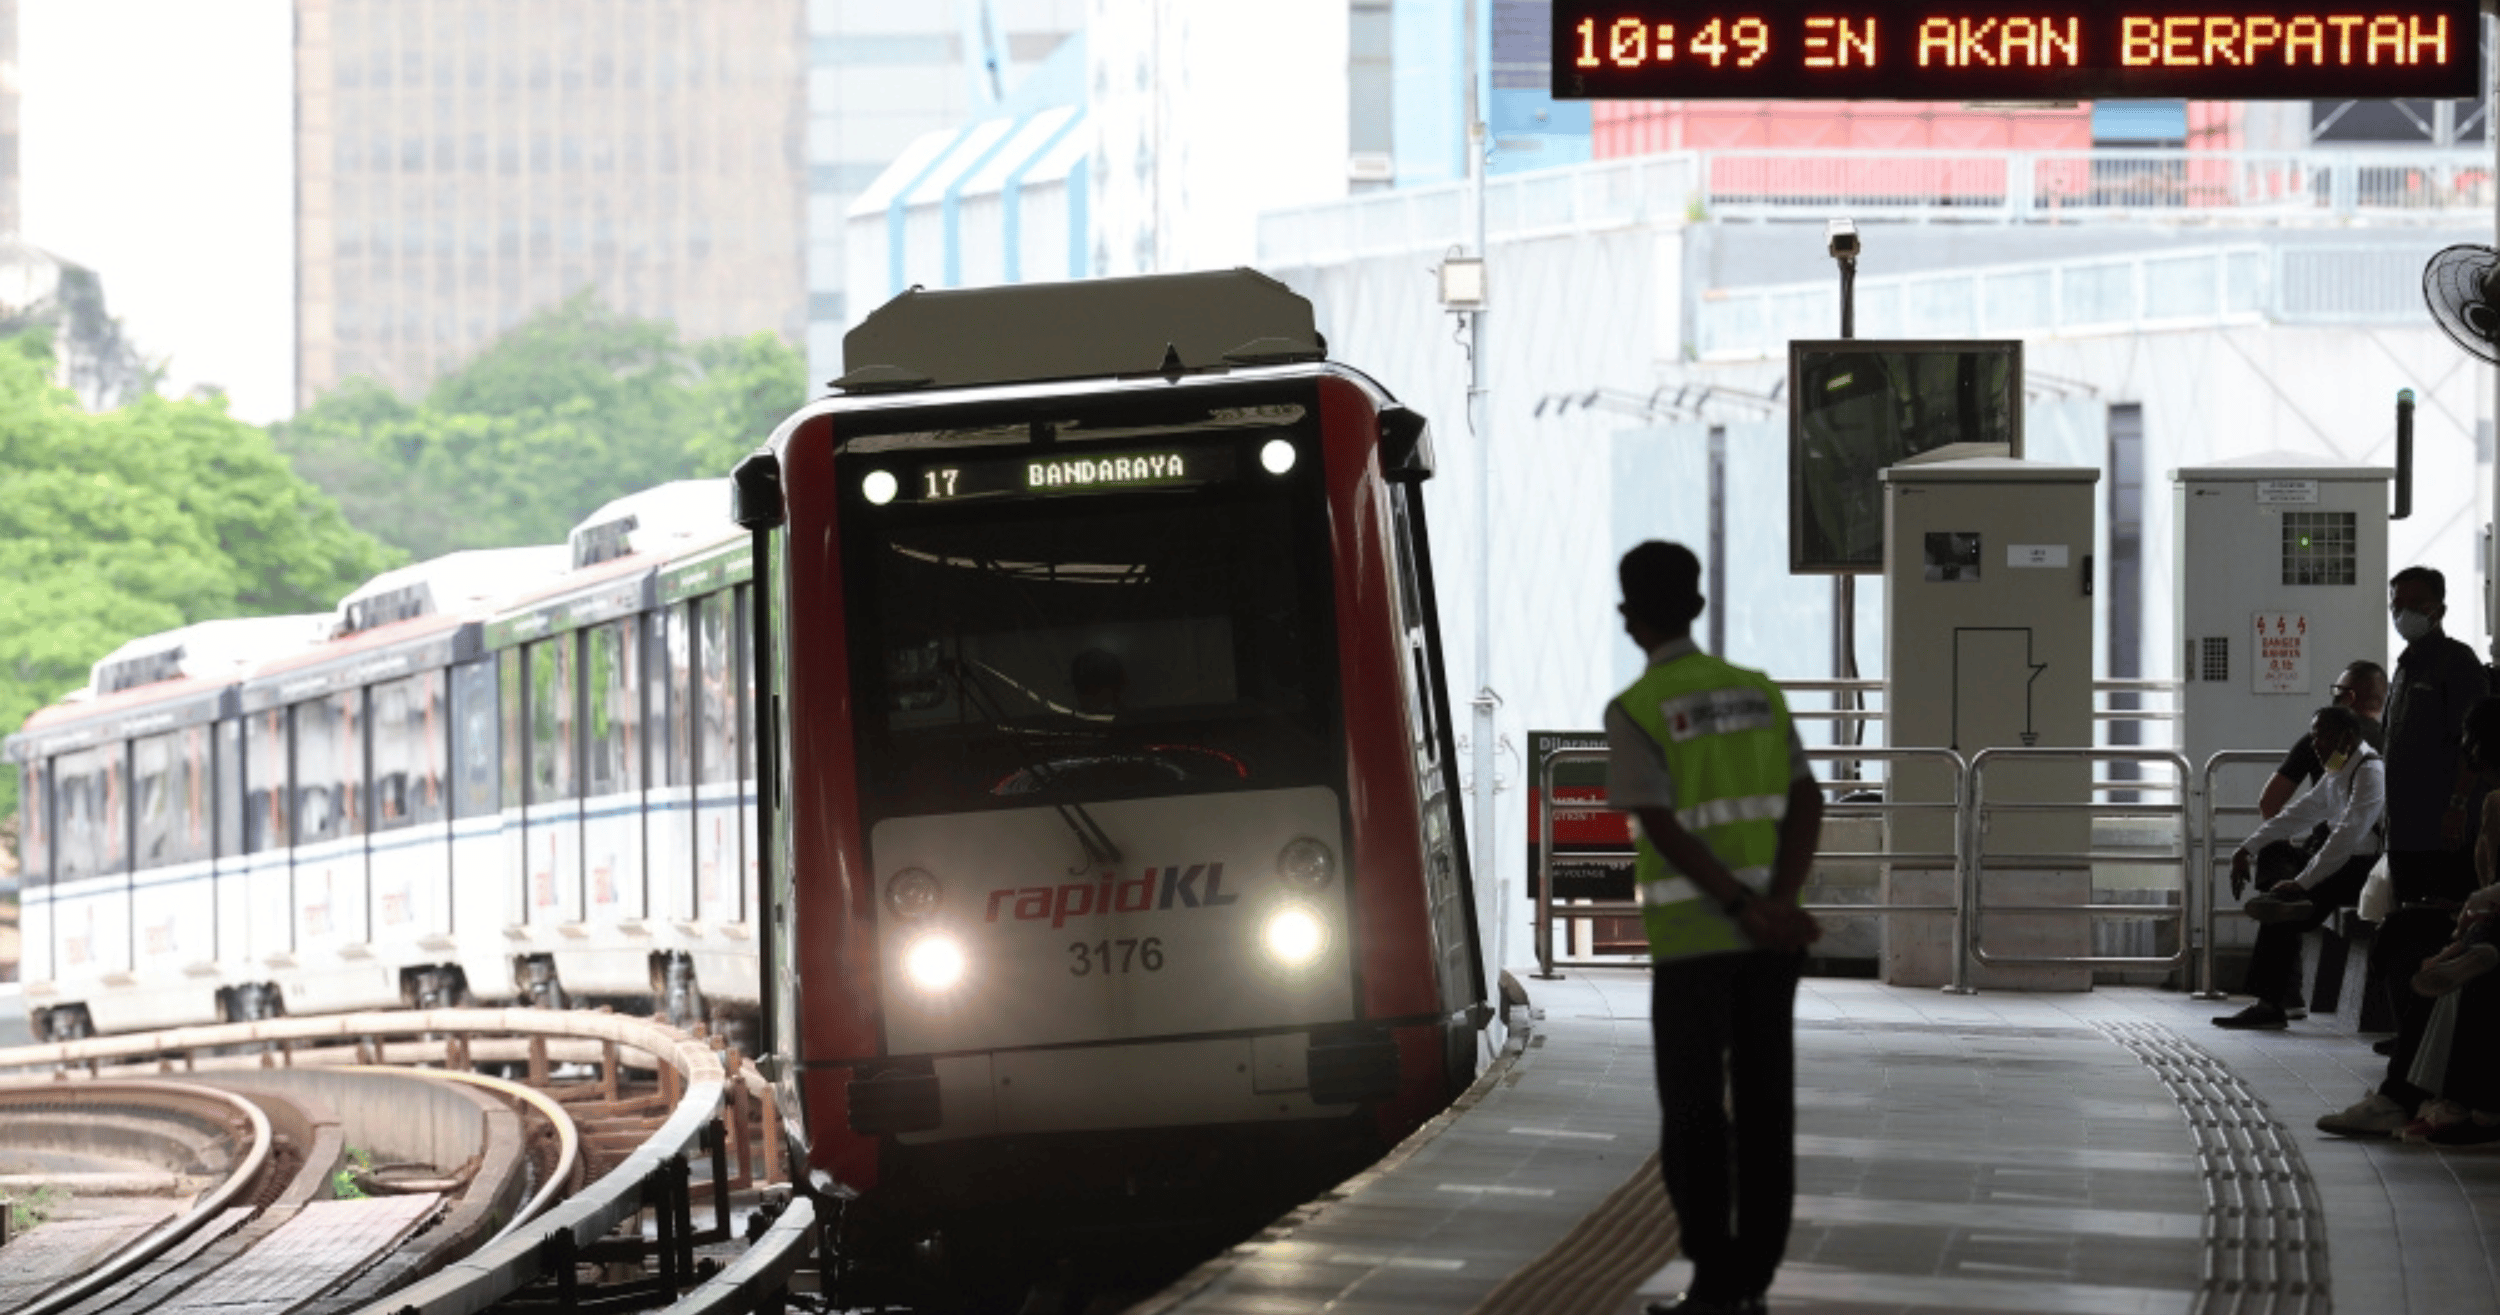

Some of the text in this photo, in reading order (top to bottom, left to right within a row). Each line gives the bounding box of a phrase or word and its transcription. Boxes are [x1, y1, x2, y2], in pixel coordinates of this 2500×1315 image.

[1576, 17, 1768, 67] 10:49
[1918, 17, 2079, 67] AKAN
[2121, 15, 2448, 66] BERPATAH
[924, 454, 1184, 498] 17 BANDARAYA
[984, 861, 1240, 930] rapidKL
[1066, 936, 1165, 978] 3176
